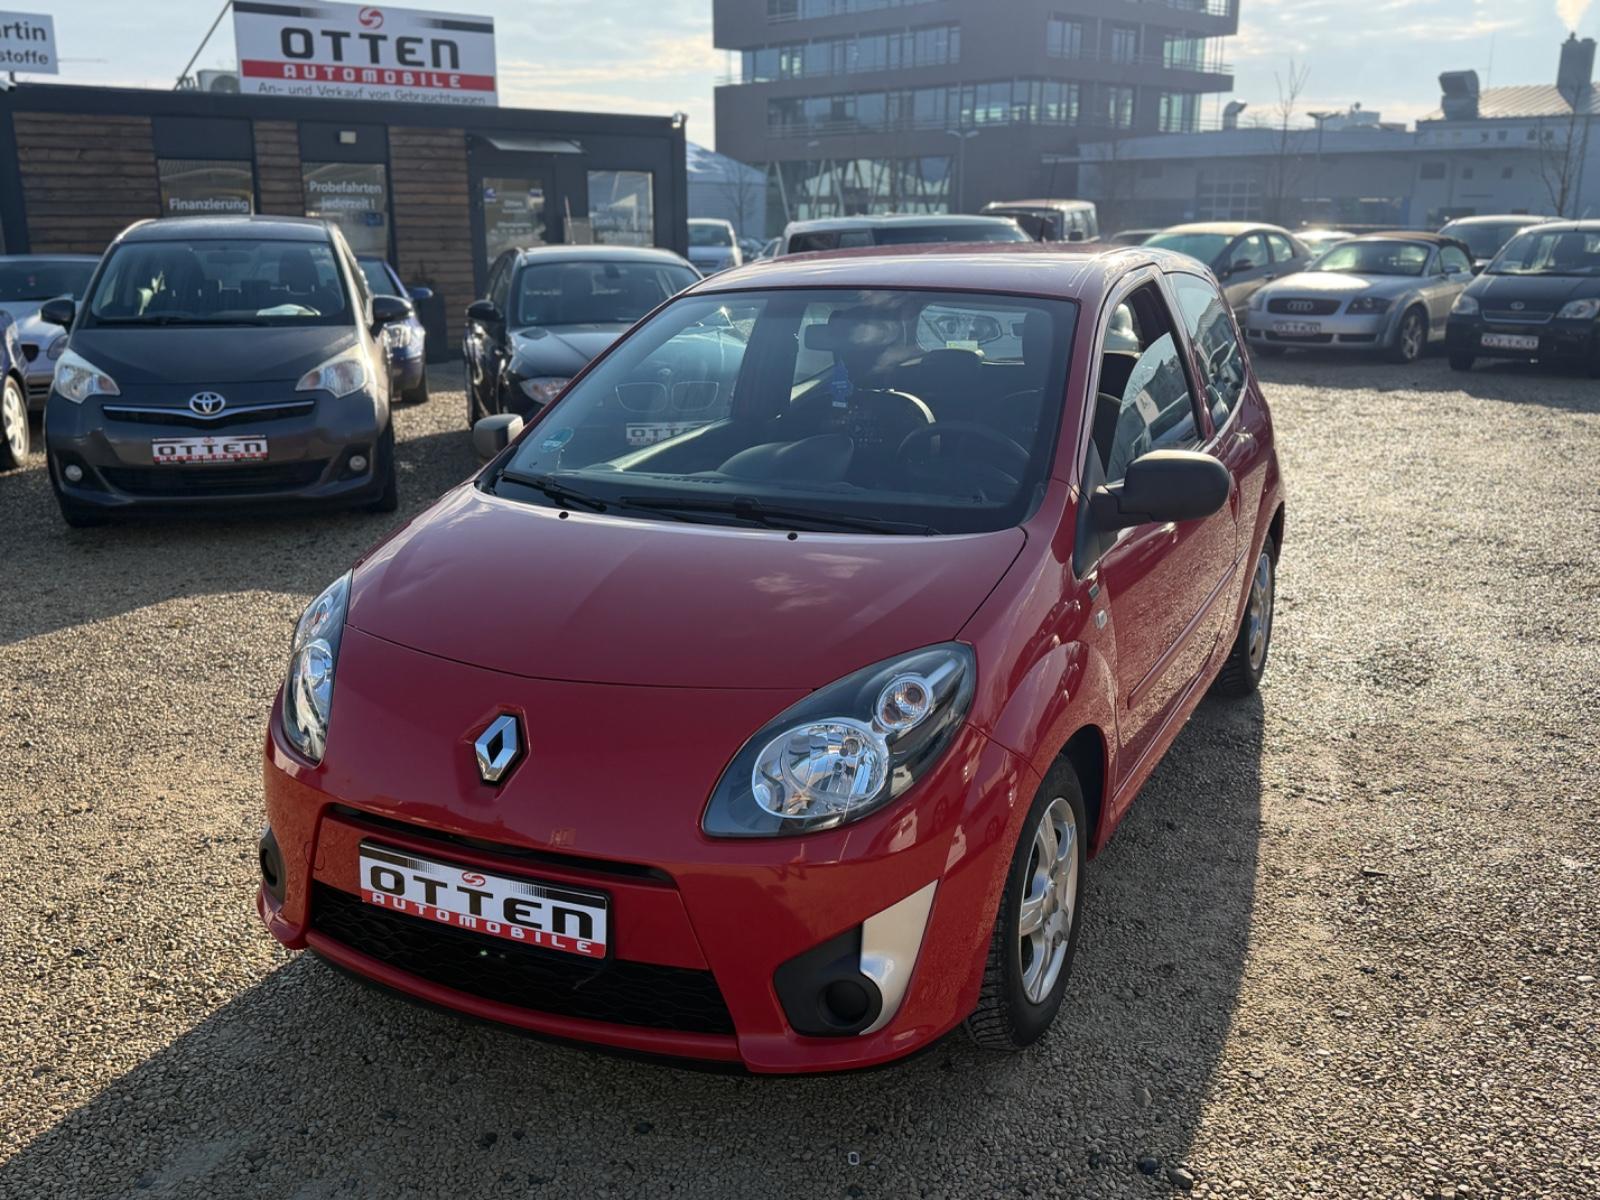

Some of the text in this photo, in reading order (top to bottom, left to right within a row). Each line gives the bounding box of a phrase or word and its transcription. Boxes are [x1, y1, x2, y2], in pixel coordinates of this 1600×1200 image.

[0, 21, 46, 41] rtin
[281, 27, 459, 69] OTTEN
[283, 64, 461, 88] AUTOMOBILE
[288, 84, 312, 95] und
[317, 85, 364, 98] Verkauf
[368, 90, 390, 99] von
[394, 89, 486, 106] Gebrauchtwagen
[309, 180, 382, 194] Probefahrten
[169, 198, 249, 212] Finanzierung
[158, 442, 262, 456] OTTEN
[370, 866, 593, 940] OTTEN
[372, 892, 592, 954] AUTOMOBILE
